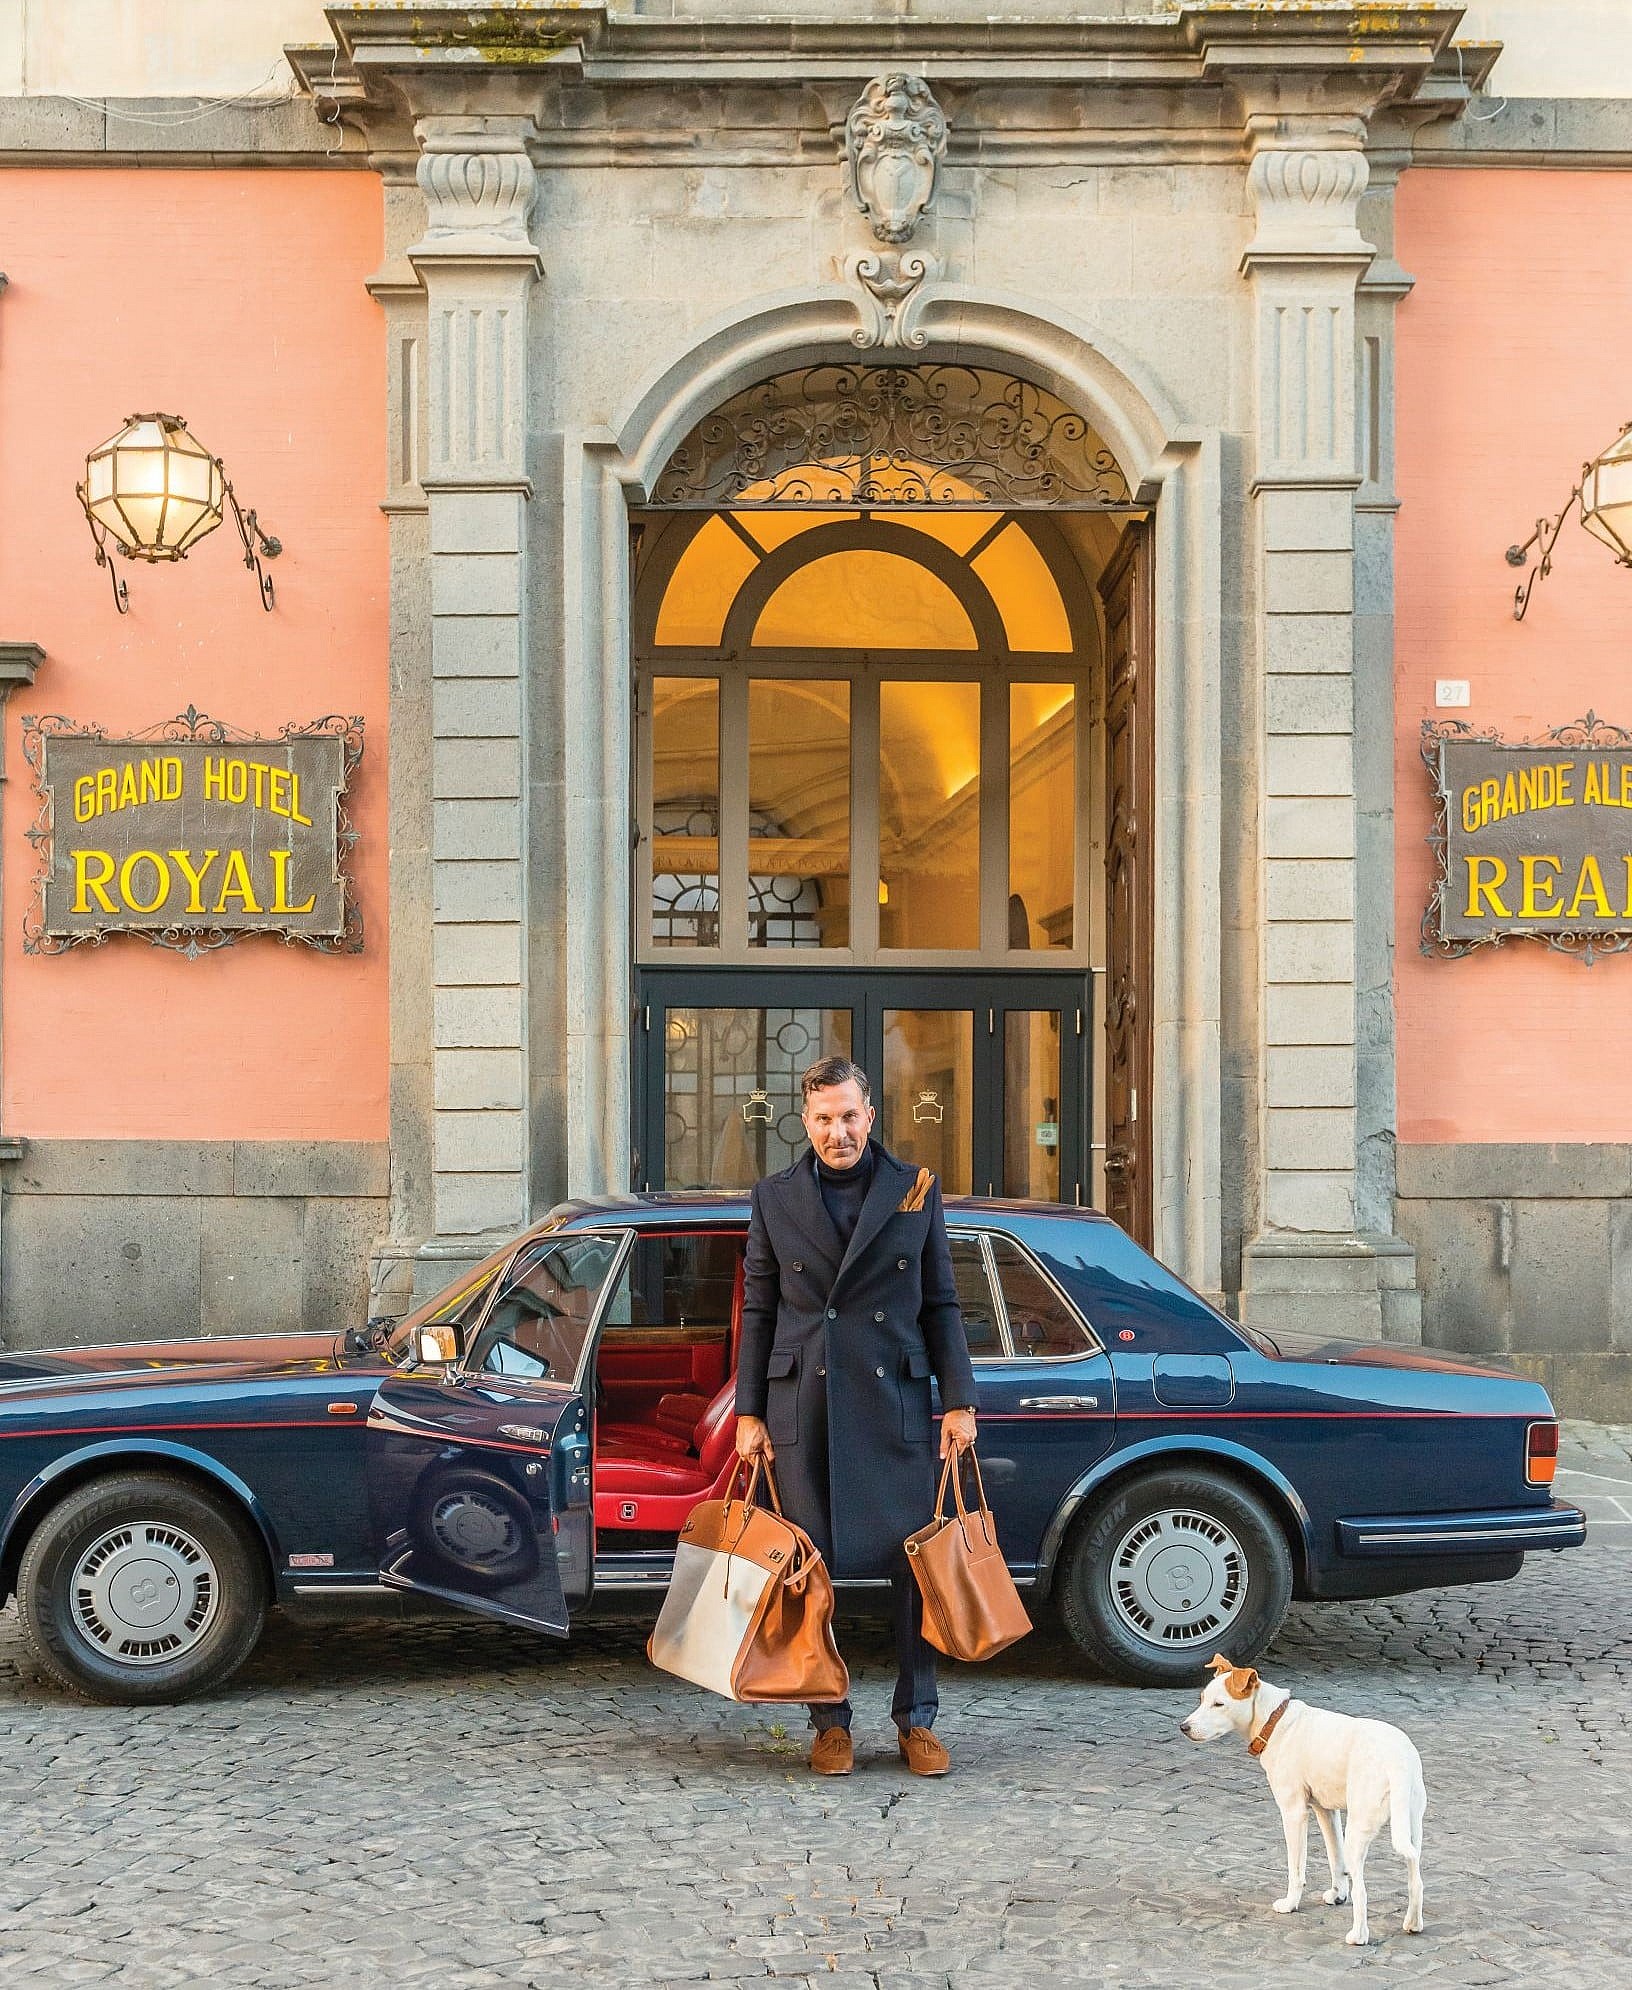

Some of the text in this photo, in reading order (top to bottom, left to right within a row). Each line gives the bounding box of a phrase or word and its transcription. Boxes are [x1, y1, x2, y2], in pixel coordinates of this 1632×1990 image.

[1441, 686, 1465, 701] 27
[74, 756, 312, 827] GRAND HOTEL
[1462, 762, 1575, 833] GRANDE
[70, 849, 317, 914] ROYAL
[1463, 854, 1632, 919] REA
[1165, 1564, 1194, 1591] B
